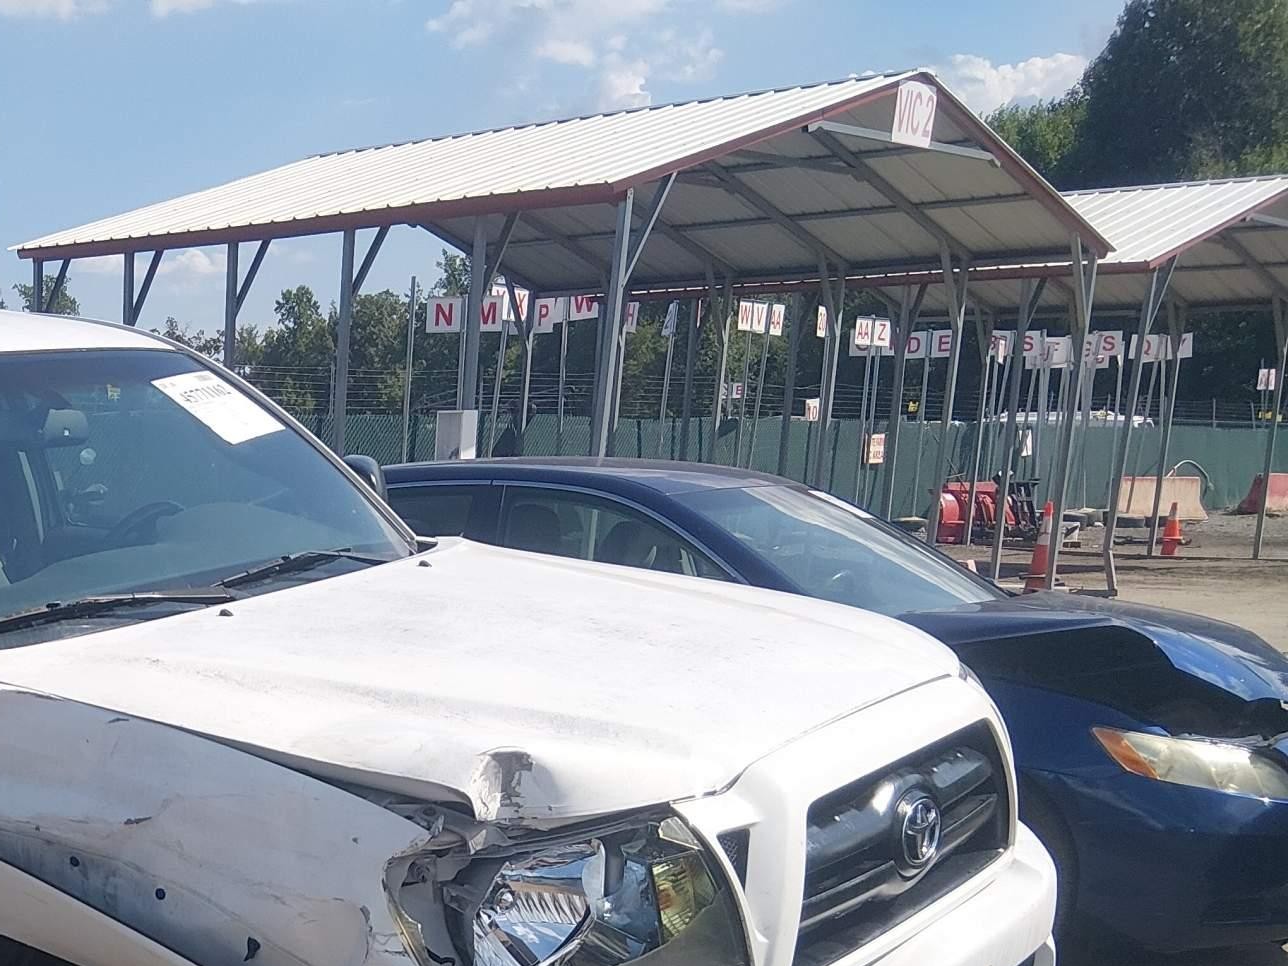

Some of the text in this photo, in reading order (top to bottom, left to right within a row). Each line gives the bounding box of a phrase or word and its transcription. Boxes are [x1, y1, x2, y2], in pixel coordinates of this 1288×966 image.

[898, 88, 934, 137] VIC 2
[435, 303, 453, 327] N
[538, 304, 550, 327] P
[740, 304, 751, 325] W
[757, 305, 765, 327] V
[857, 321, 870, 340] AA
[878, 323, 887, 341] Z
[908, 336, 921, 354] D
[938, 334, 952, 353] E
[1023, 335, 1034, 352] S
[1102, 335, 1115, 352] S
